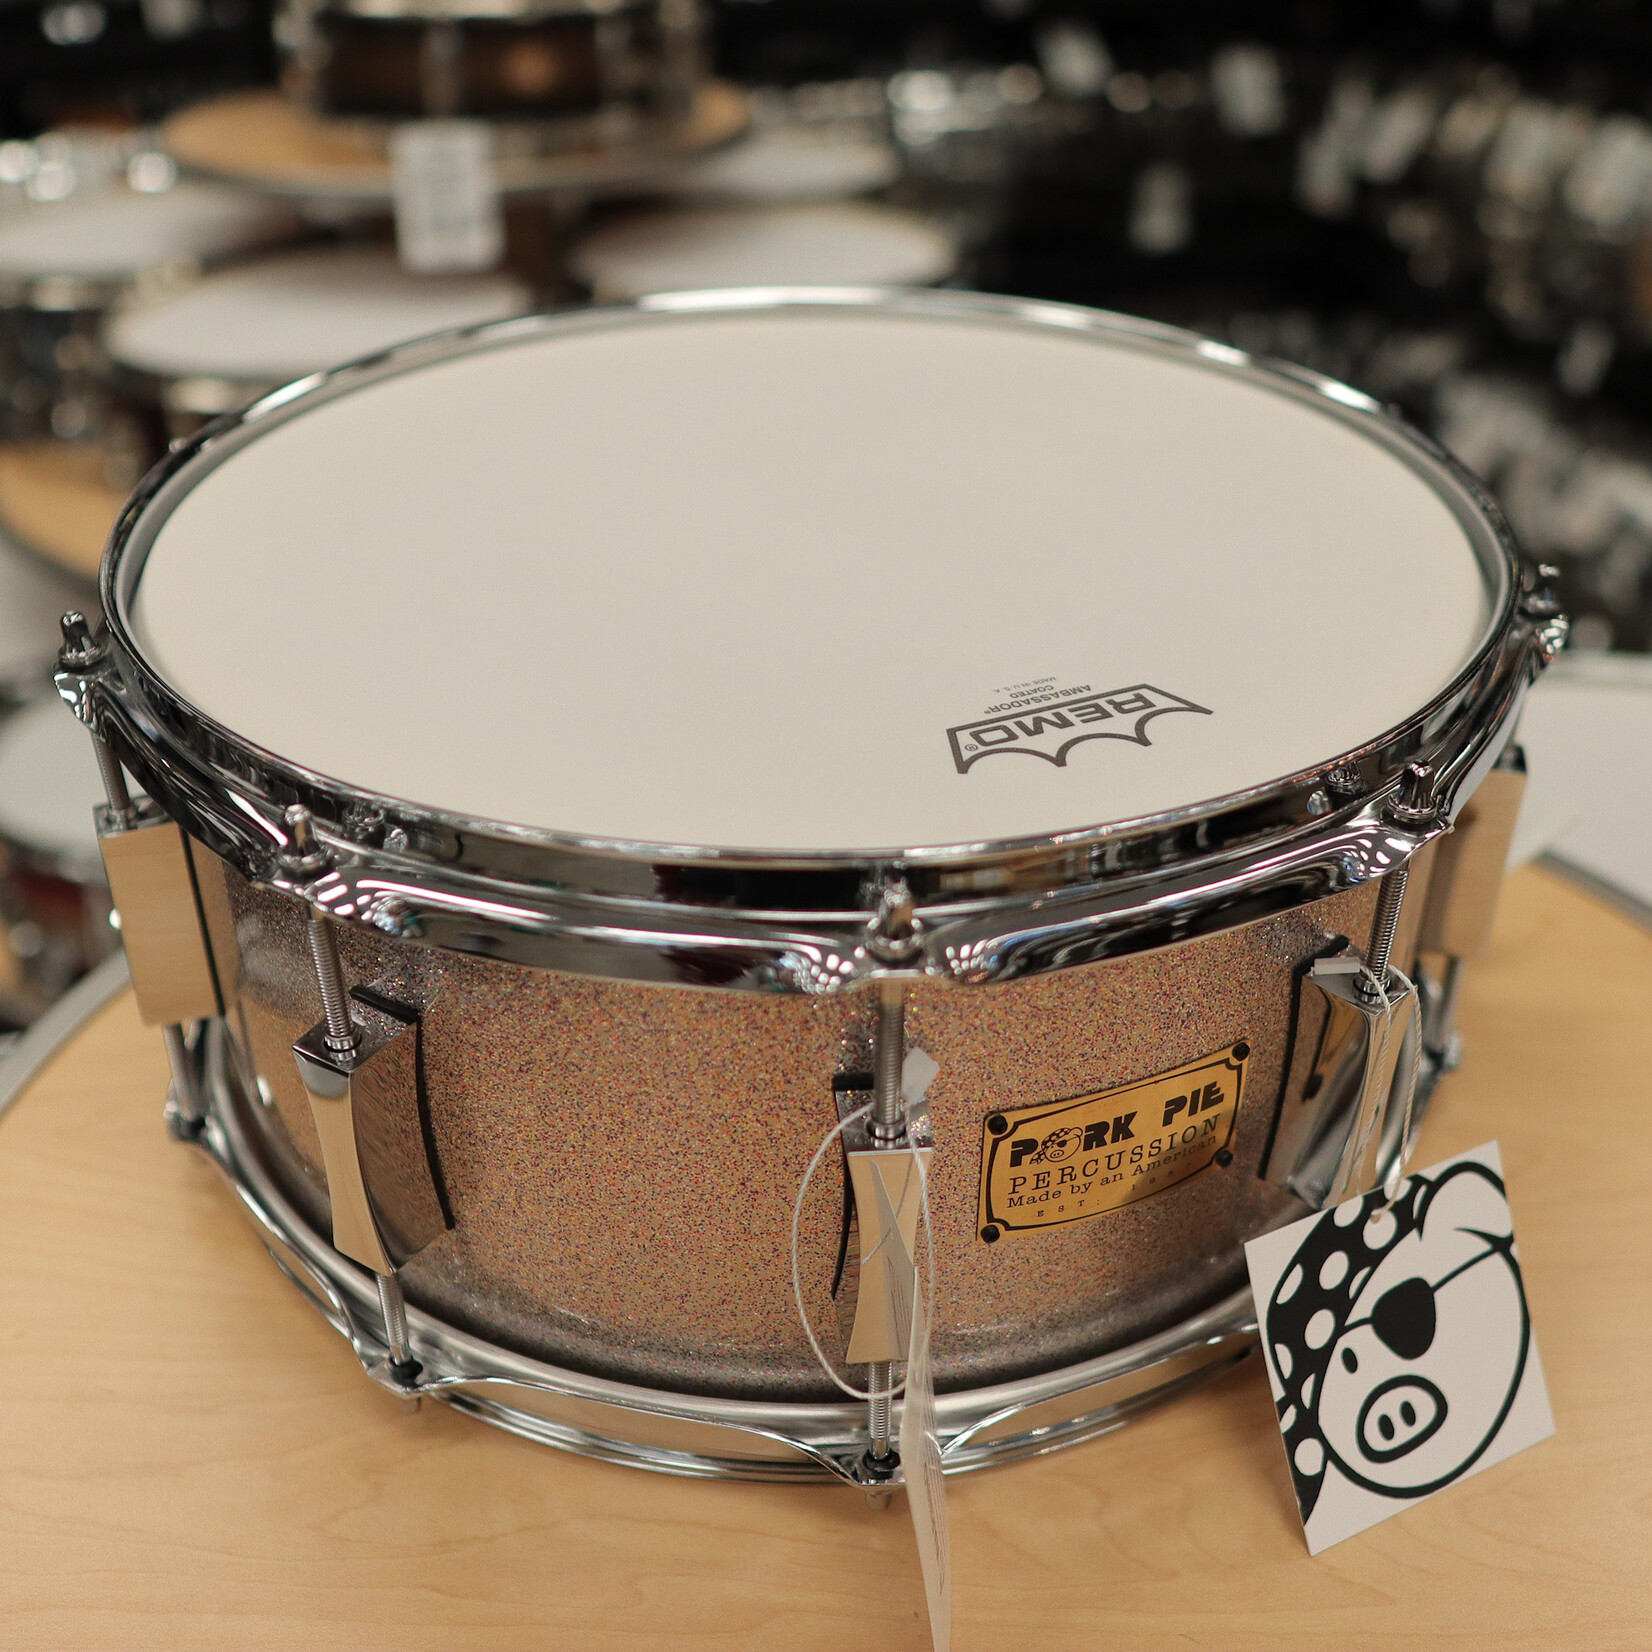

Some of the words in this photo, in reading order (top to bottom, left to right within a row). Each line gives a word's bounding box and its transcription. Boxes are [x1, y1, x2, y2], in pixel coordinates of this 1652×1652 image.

[1009, 685, 1054, 699] COATED
[1032, 676, 1057, 685] MADE
[1162, 1081, 1225, 1127] PIE
[1006, 1189, 1062, 1209] Made
[1070, 1181, 1094, 1195] by
[1100, 1172, 1124, 1186] an
[1131, 1136, 1217, 1177] American
[1008, 1113, 1221, 1195] PERCUSSION
